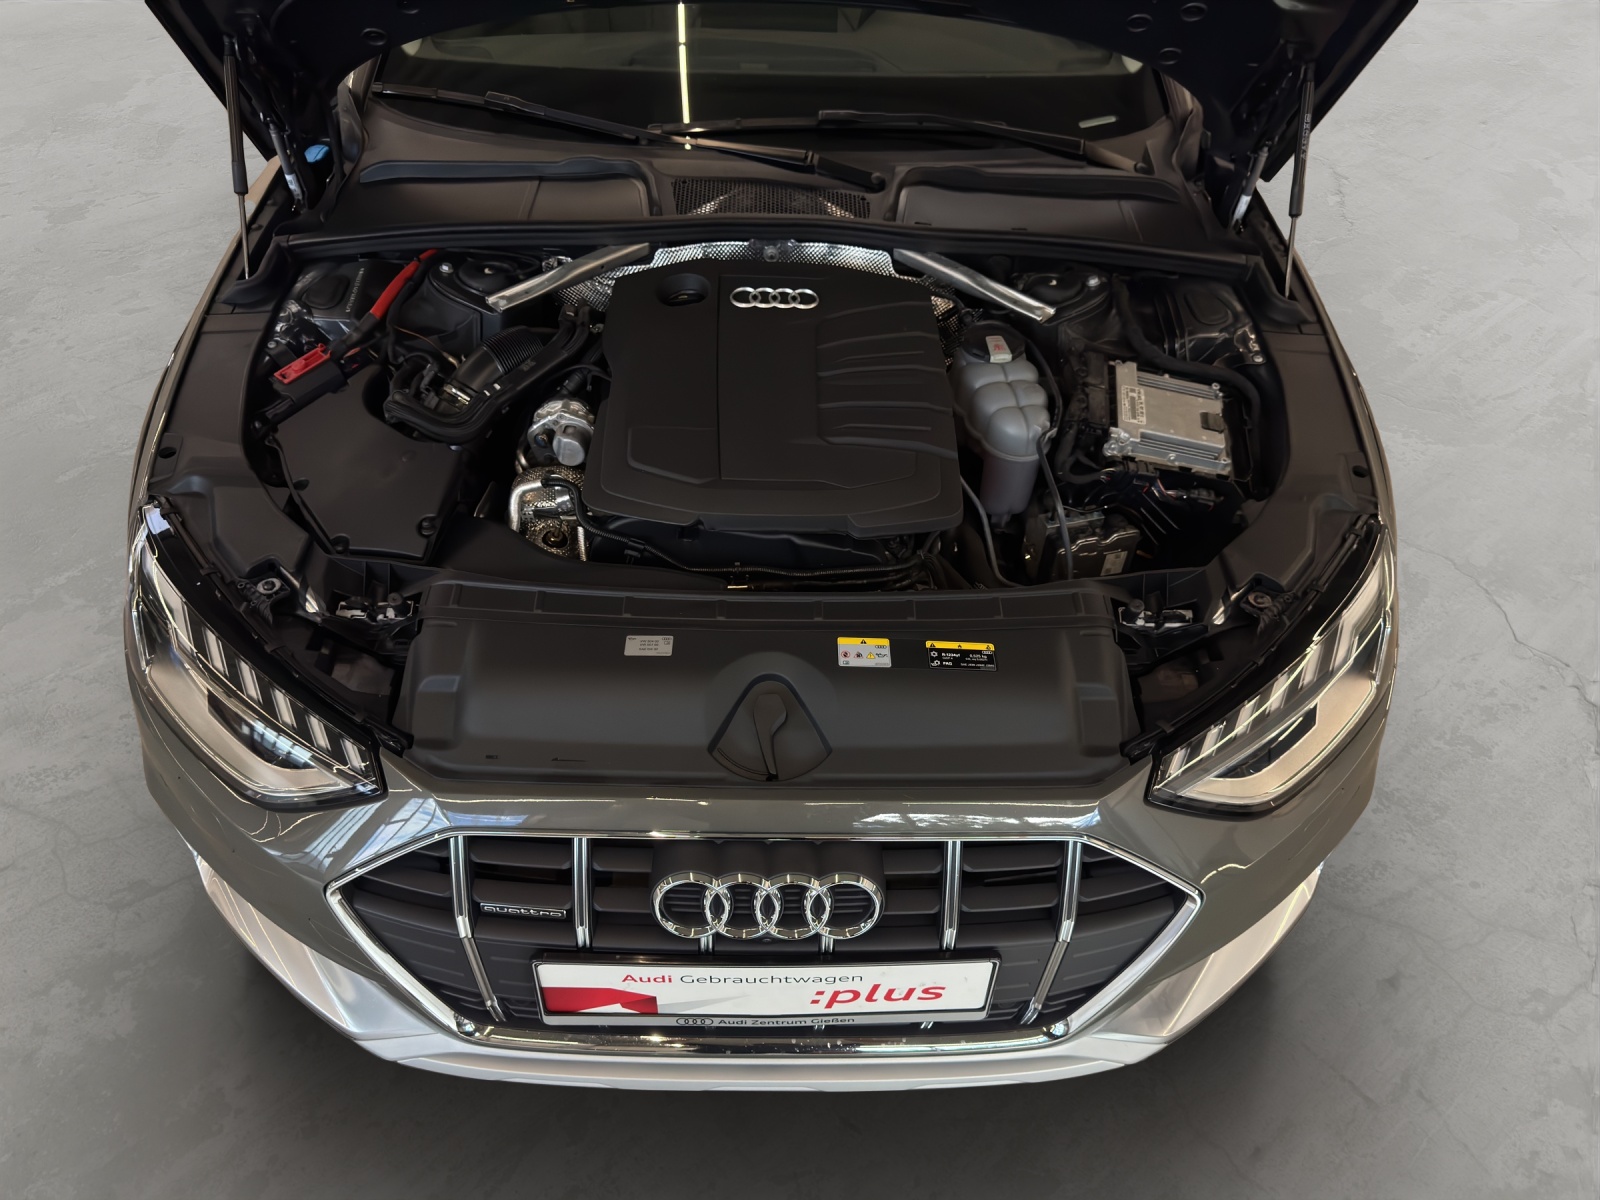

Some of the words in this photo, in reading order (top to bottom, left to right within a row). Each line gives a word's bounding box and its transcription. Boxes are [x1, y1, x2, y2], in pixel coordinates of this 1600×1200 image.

[484, 906, 562, 917] quattro
[621, 974, 673, 983] Audi
[680, 975, 863, 985] Gebrauchtwagen
